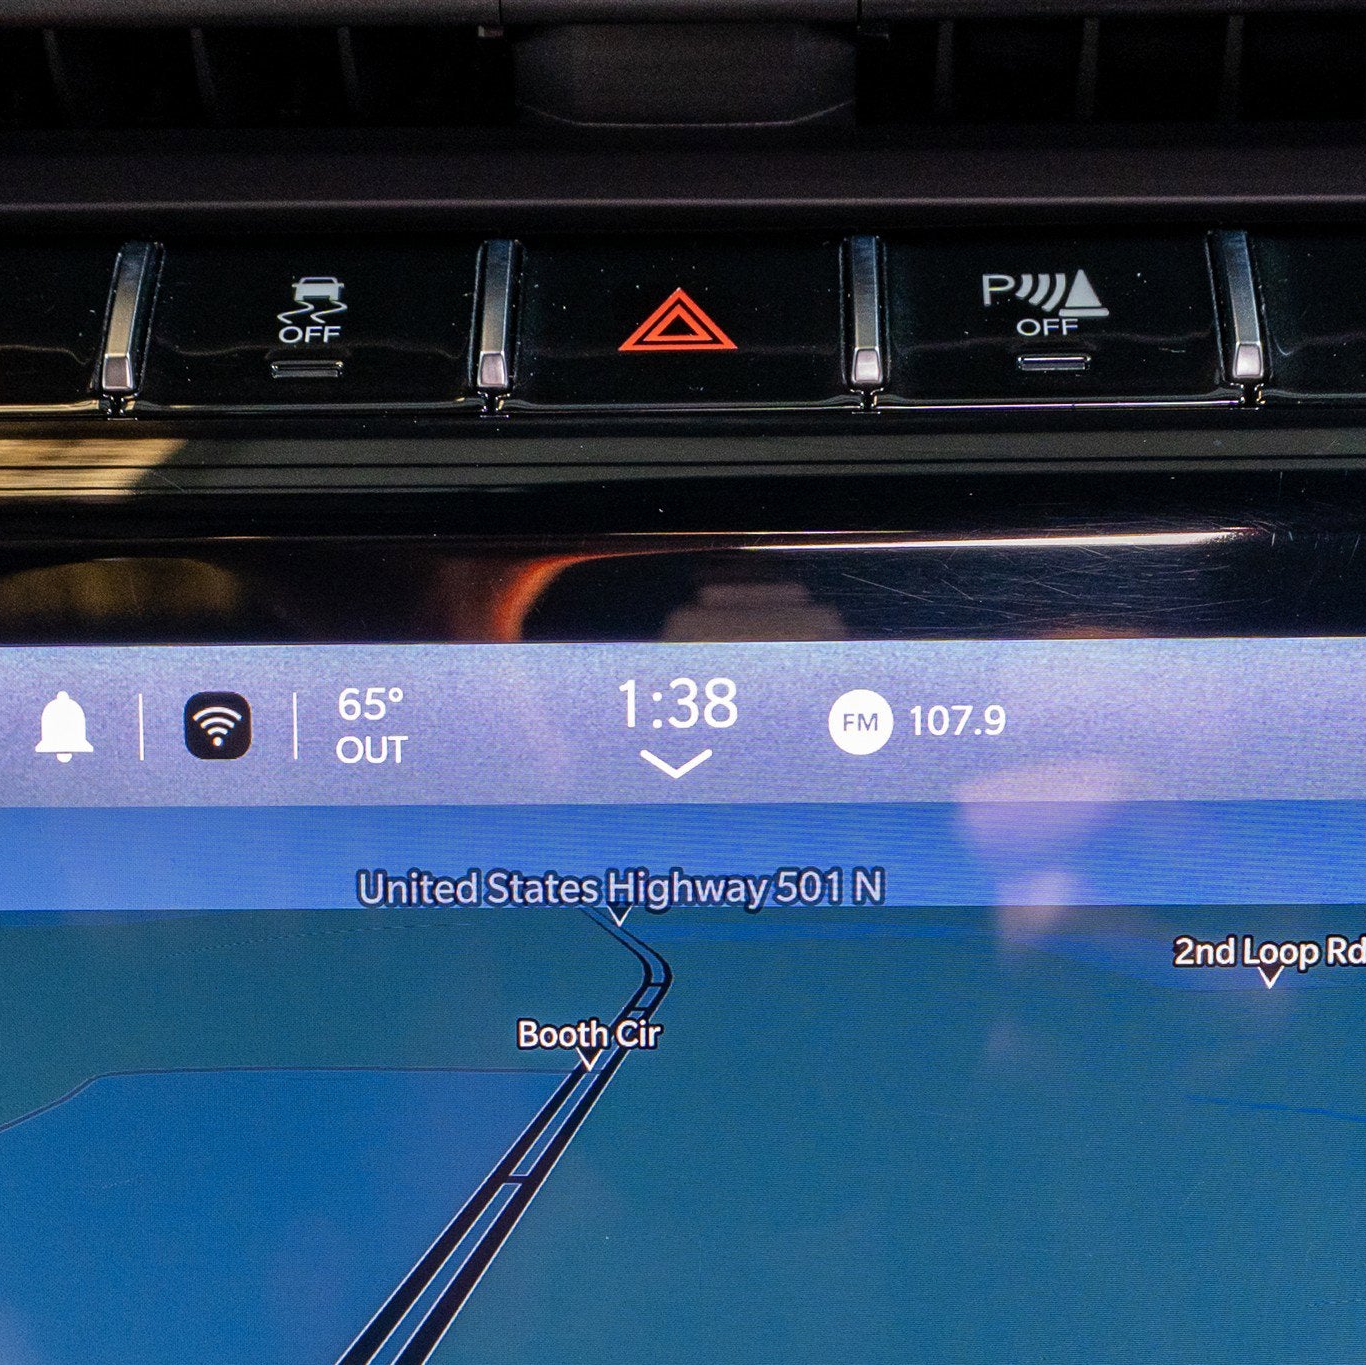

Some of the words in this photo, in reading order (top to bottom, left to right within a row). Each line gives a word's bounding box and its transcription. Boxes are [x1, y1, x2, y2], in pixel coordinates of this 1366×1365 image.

[278, 325, 341, 344] OFF
[1016, 318, 1078, 337] OFF
[618, 676, 738, 729] 1:38
[843, 712, 879, 732] FM
[910, 704, 1006, 736] 107.9
[335, 735, 409, 764] OUT
[359, 871, 478, 905] United
[488, 872, 599, 904] States
[608, 870, 768, 911] Highway
[776, 870, 839, 902] 501
[855, 870, 881, 902] N
[1175, 937, 1235, 965] 2nd
[1244, 937, 1320, 971] Loop
[519, 1019, 608, 1048] Booth
[616, 1019, 661, 1048] Cir
